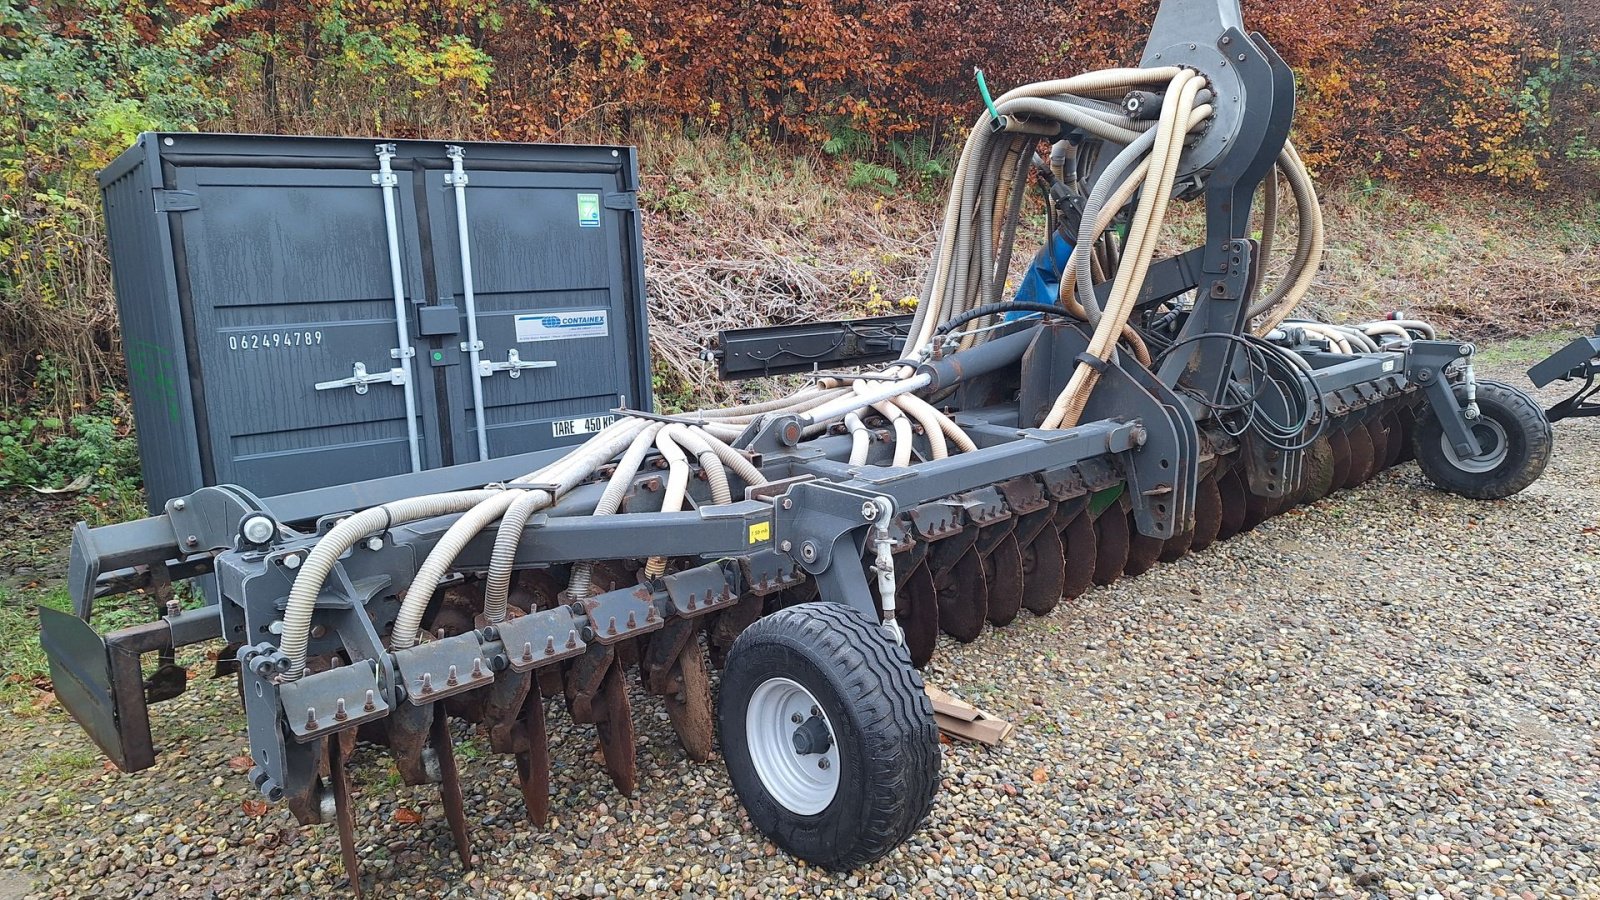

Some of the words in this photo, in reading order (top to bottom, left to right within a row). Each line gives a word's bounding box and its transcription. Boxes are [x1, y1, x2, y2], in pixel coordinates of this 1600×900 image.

[562, 315, 605, 325] CONTAINEX
[229, 331, 322, 350] 062494789
[554, 420, 575, 436] TARE
[584, 417, 602, 432] 450
